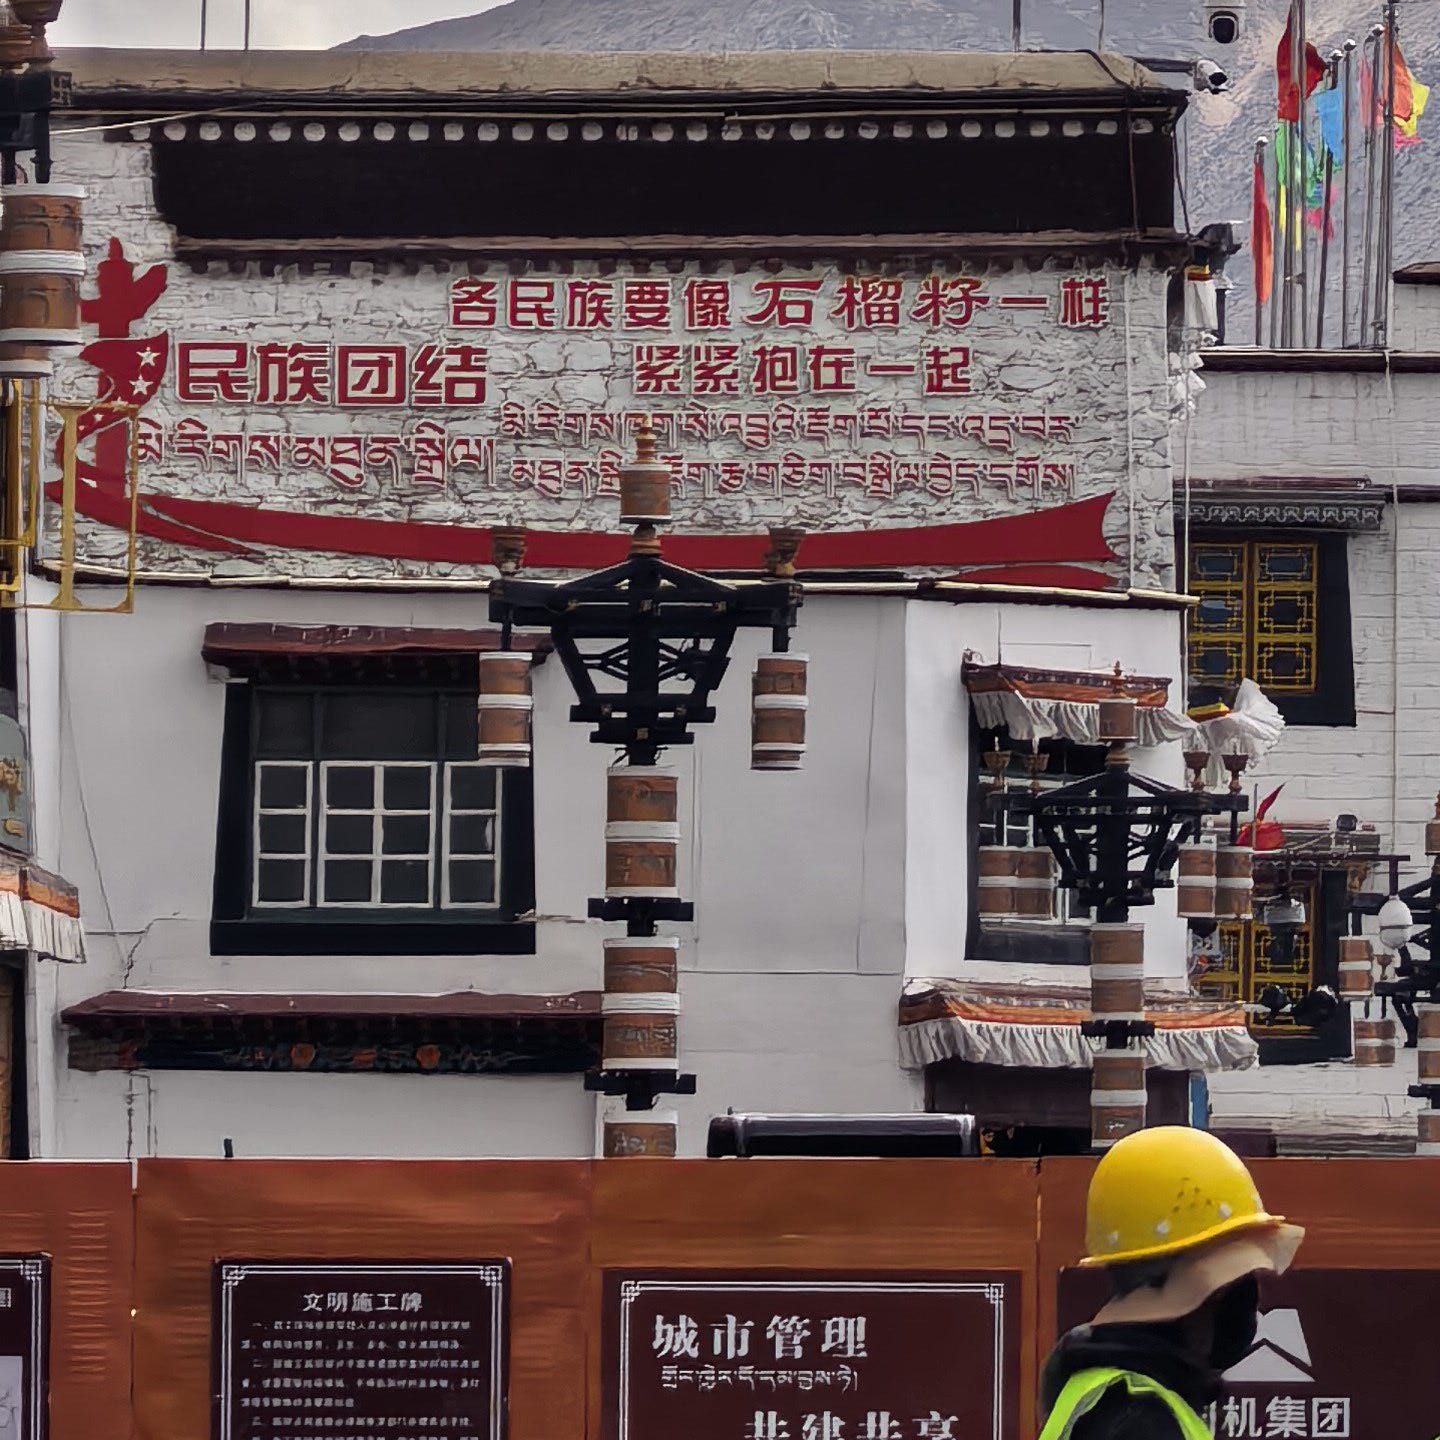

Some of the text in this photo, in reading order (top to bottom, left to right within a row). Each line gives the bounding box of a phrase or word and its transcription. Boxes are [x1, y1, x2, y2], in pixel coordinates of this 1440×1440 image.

[450, 276, 1109, 328] 各民族要像石榴籽一样
[177, 341, 488, 406] 民族团结
[634, 343, 974, 395] 紧紧抱在一起
[302, 1292, 423, 1313] 文明施工牌
[652, 1314, 868, 1360] 城市管理
